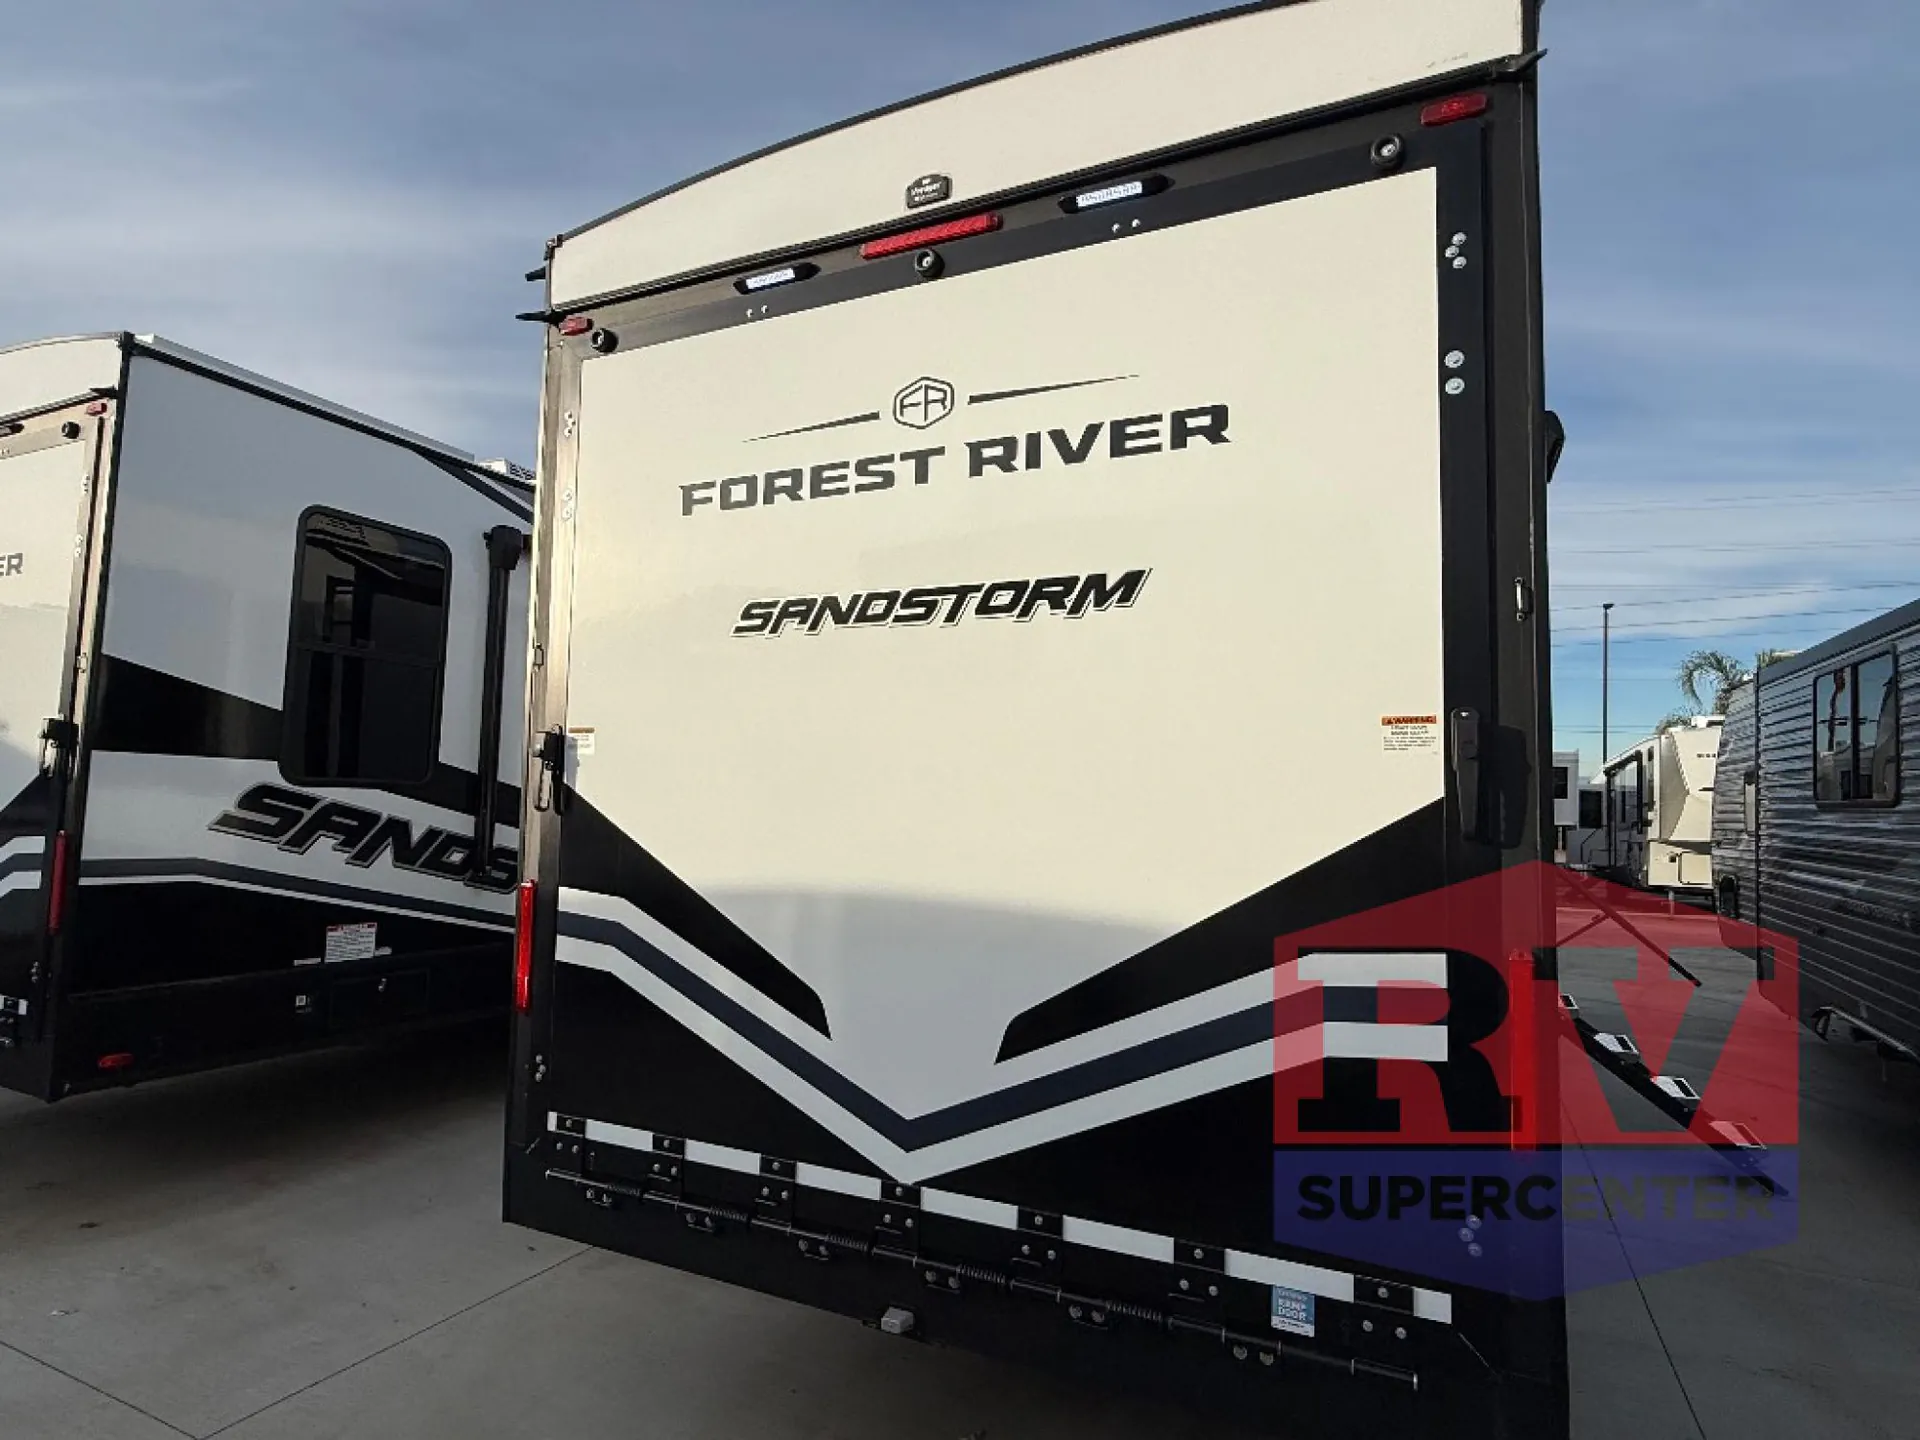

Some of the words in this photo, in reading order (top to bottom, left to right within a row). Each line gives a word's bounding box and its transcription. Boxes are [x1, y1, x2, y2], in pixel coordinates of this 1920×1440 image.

[679, 446, 946, 516] FOREST
[964, 404, 1231, 478] RIVER
[730, 567, 1153, 639] SANDSTORM
